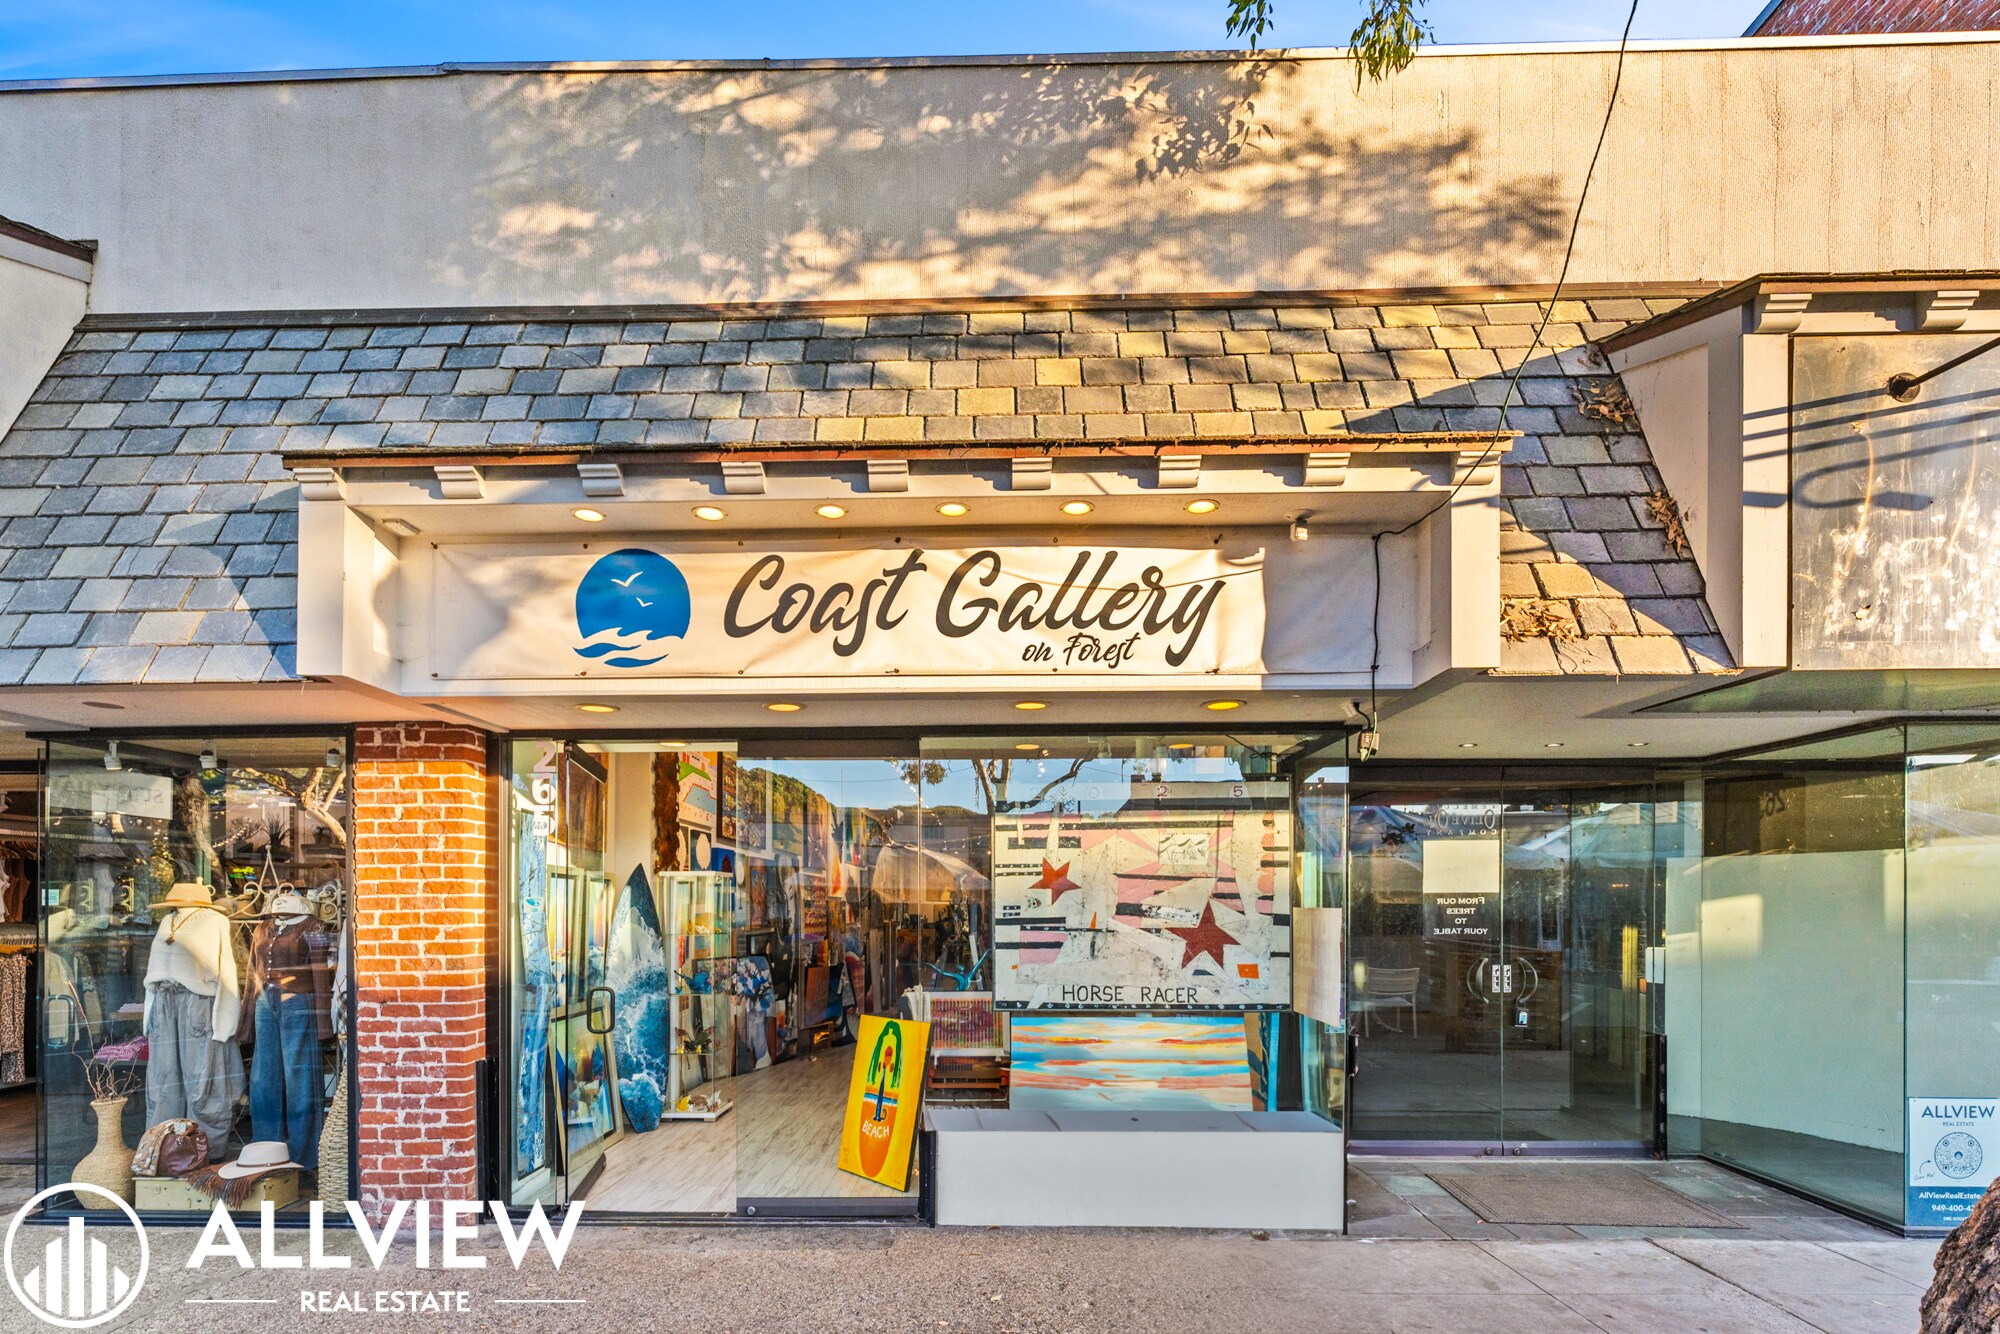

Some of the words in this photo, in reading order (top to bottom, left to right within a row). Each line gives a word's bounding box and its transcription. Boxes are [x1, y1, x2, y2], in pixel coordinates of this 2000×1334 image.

[723, 548, 928, 657] Coast
[935, 548, 1227, 666] Gallery
[1021, 641, 1054, 662] on
[1062, 631, 1141, 669] Forest
[1233, 785, 1244, 798] 5
[1062, 985, 1124, 1002] HORSE
[1140, 986, 1198, 1003] RACER
[1921, 1105, 1995, 1118] ALLVIEW
[861, 1119, 890, 1138] BEACH
